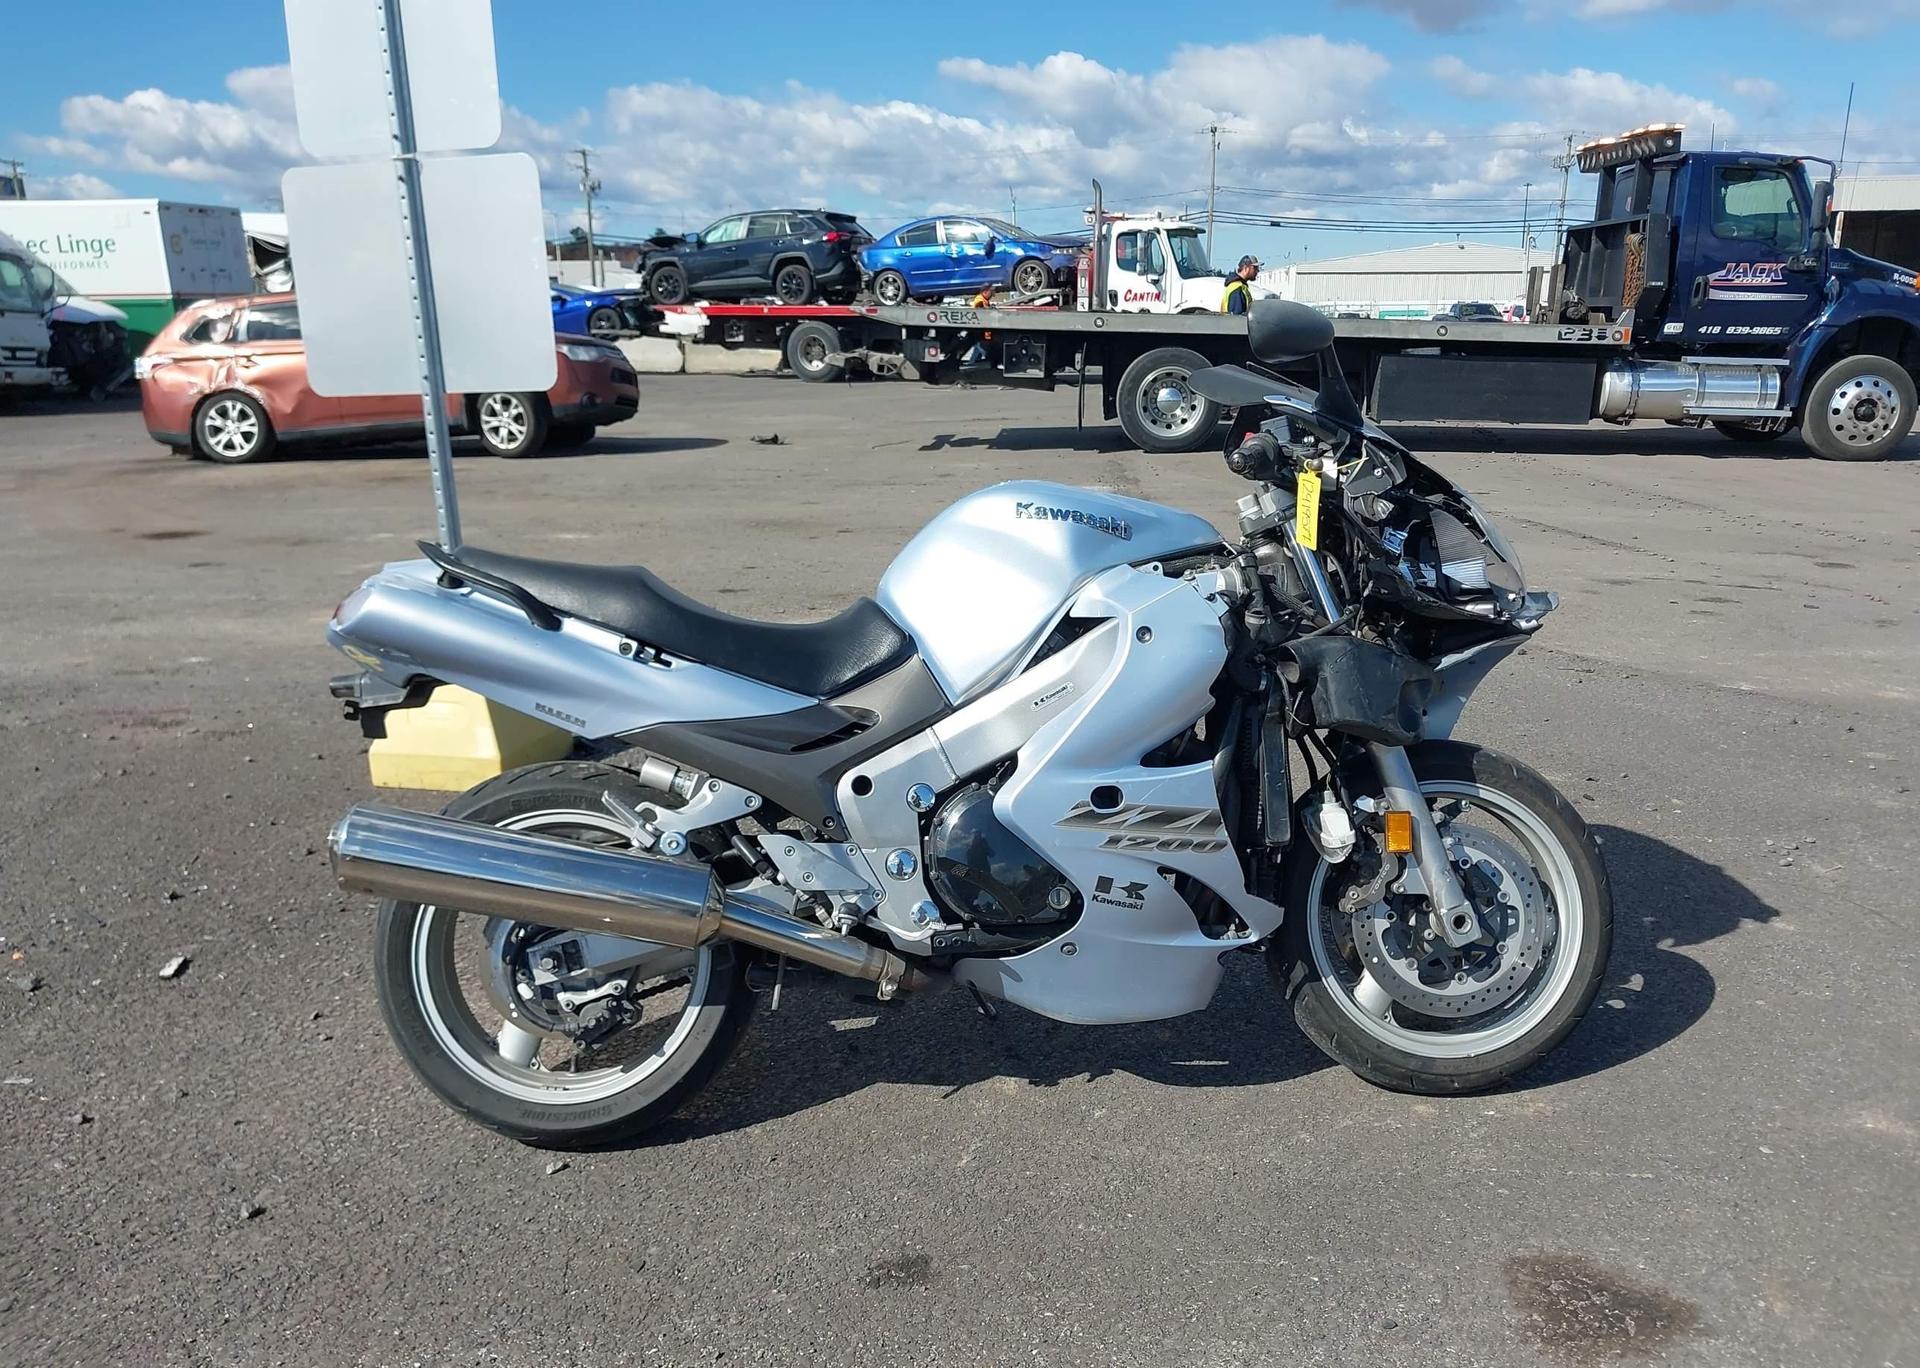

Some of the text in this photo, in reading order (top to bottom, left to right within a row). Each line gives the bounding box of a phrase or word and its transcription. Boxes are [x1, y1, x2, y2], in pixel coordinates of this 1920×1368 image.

[57, 234, 116, 259] Linge
[48, 260, 110, 269] NIFORMES
[1716, 262, 1787, 280] JACK
[1698, 325, 1721, 334] 418
[1725, 326, 1782, 335] 839-9865
[1016, 502, 1133, 541] Kawasaki
[1098, 834, 1228, 853] 1200
[1371, 863, 1391, 895] TOKICO
[1092, 893, 1144, 910] Kawasaki
